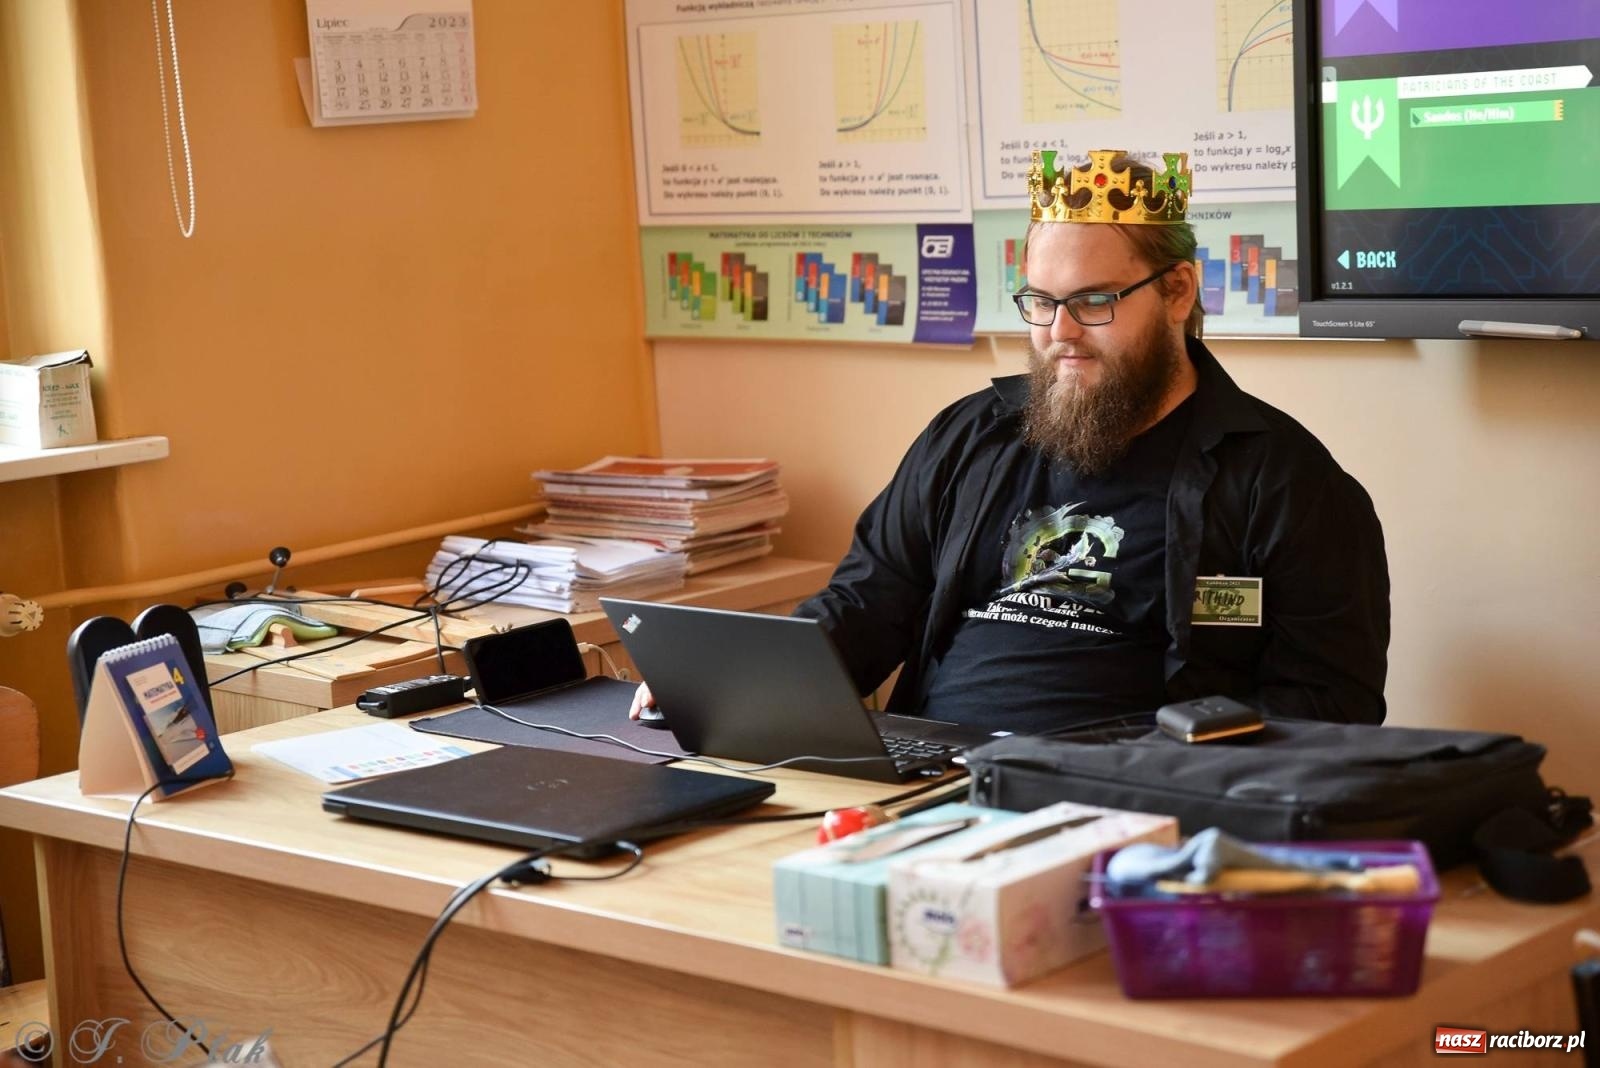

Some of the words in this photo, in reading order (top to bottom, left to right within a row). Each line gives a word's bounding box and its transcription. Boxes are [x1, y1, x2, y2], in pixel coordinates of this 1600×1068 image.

[316, 18, 349, 30] Lipiec
[427, 16, 468, 29] 2023
[1474, 78, 1487, 89] OF
[1494, 75, 1514, 87] THE
[1519, 73, 1558, 86] COAST
[1193, 132, 1216, 142] Jeśli
[1194, 148, 1204, 157] to
[1207, 146, 1243, 157] funkcja
[1194, 163, 1208, 173] Do
[1210, 161, 1252, 174] wykresu
[1255, 160, 1288, 171] należy
[1355, 250, 1397, 269] BACK
[1331, 281, 1353, 290] v1.2.1
[1312, 320, 1348, 328] TouchScreen
[1354, 320, 1365, 328] Lite
[1001, 612, 1028, 623] może
[1029, 616, 1069, 628] czegoś
[1218, 615, 1256, 623] Organizator
[173, 667, 185, 685] 4
